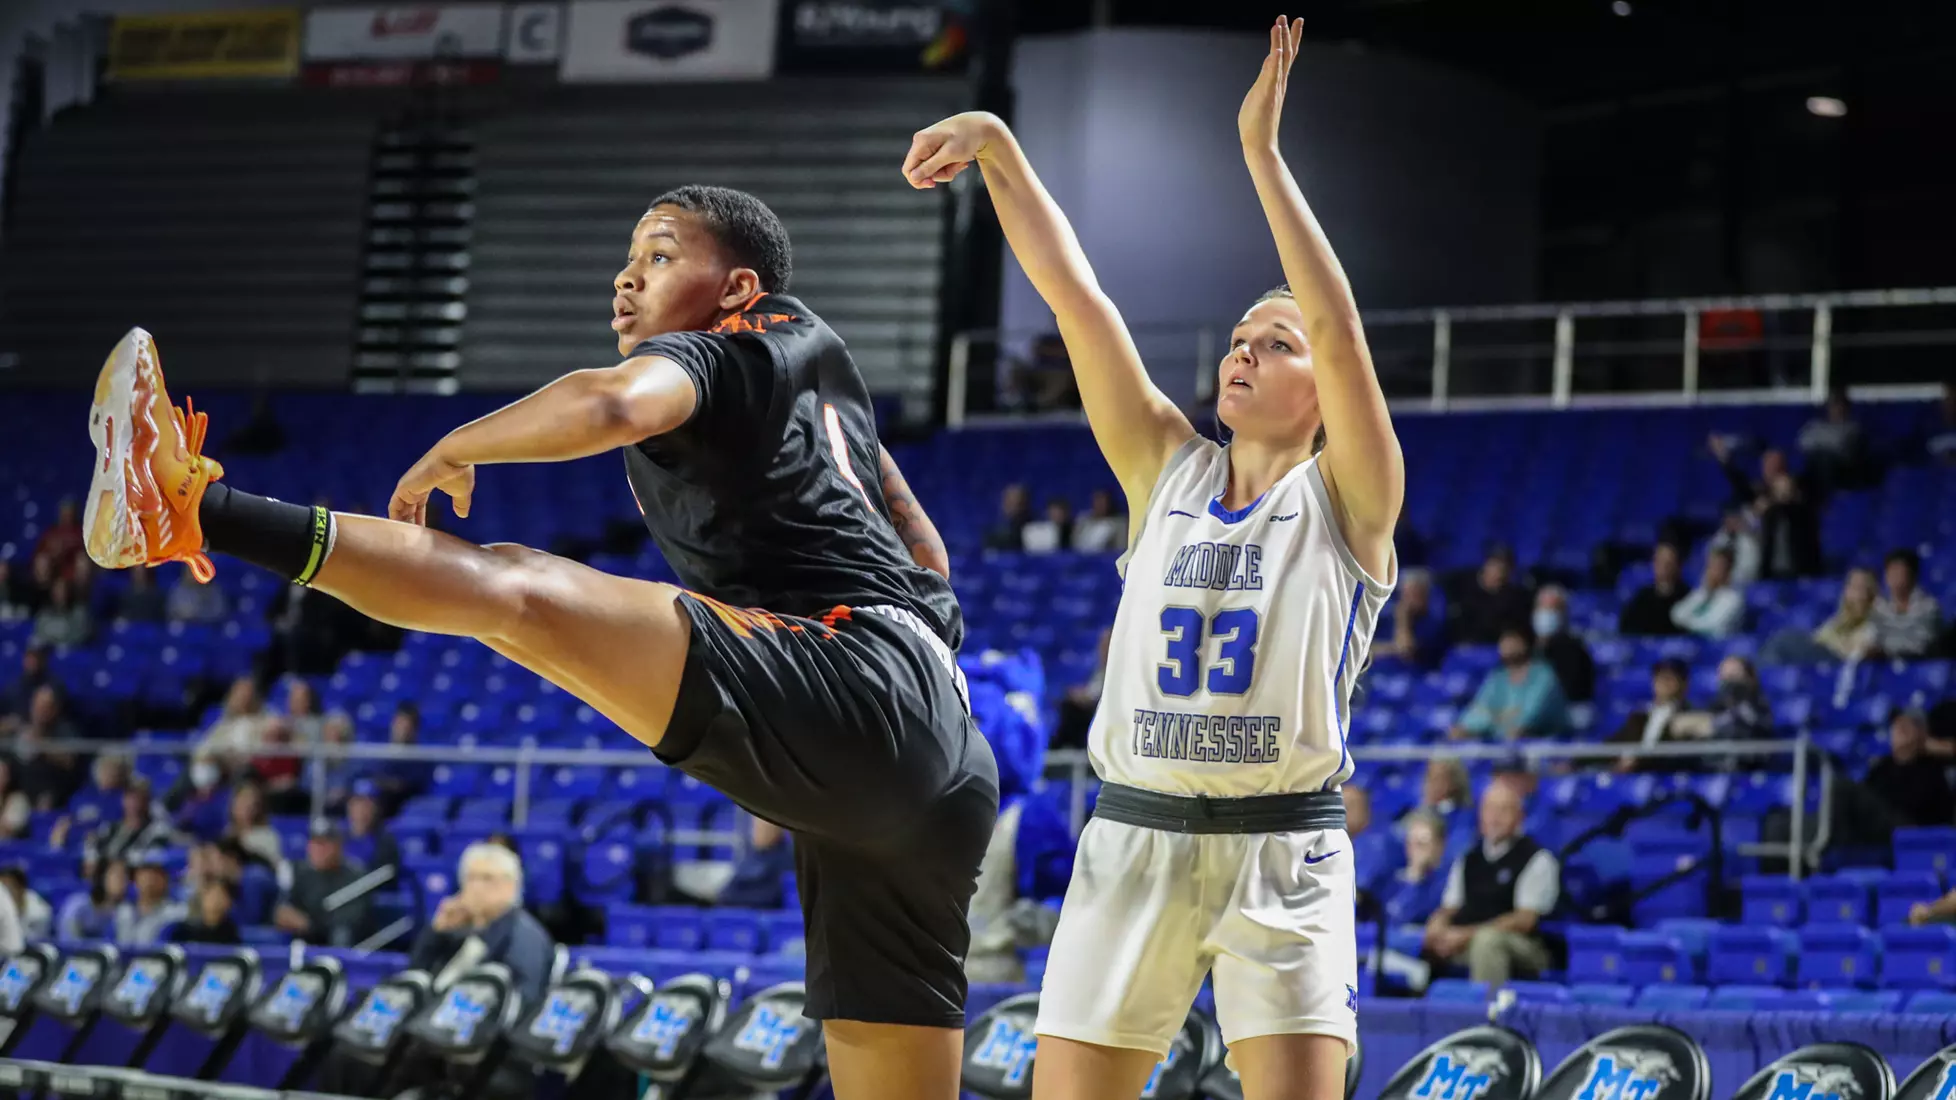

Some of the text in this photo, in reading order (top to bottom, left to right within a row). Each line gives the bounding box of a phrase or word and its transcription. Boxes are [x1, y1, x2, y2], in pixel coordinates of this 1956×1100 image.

[1164, 542, 1262, 591] MIDDLE
[1156, 604, 1261, 700] 33
[1132, 709, 1280, 763] TENNESSEE
